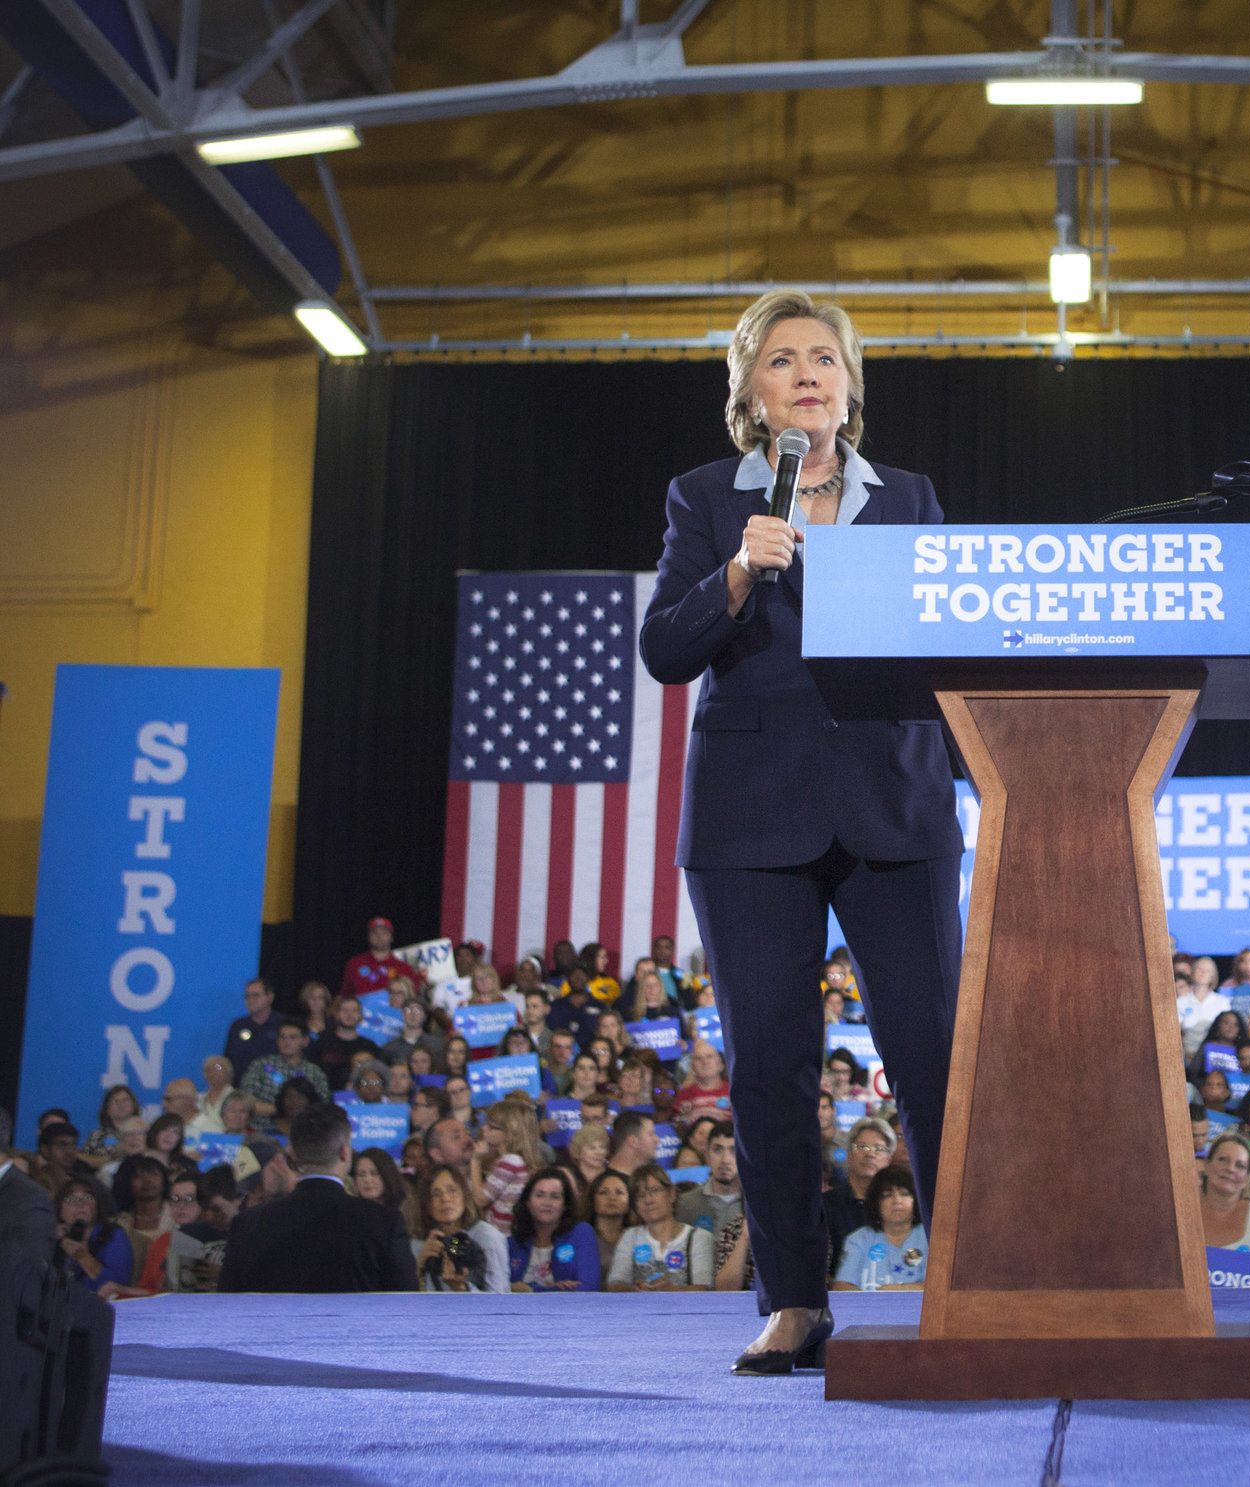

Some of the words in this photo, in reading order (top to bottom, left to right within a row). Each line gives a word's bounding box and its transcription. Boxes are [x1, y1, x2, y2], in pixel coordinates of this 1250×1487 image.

[914, 534, 1224, 574] STRONGER
[913, 582, 1224, 623] TOGETHER
[1025, 631, 1135, 647] hillaryclinton.com
[102, 721, 188, 1118] STRON
[477, 1012, 514, 1026] Clinton
[495, 1065, 538, 1080] Clinton
[361, 1116, 407, 1128] Clinton
